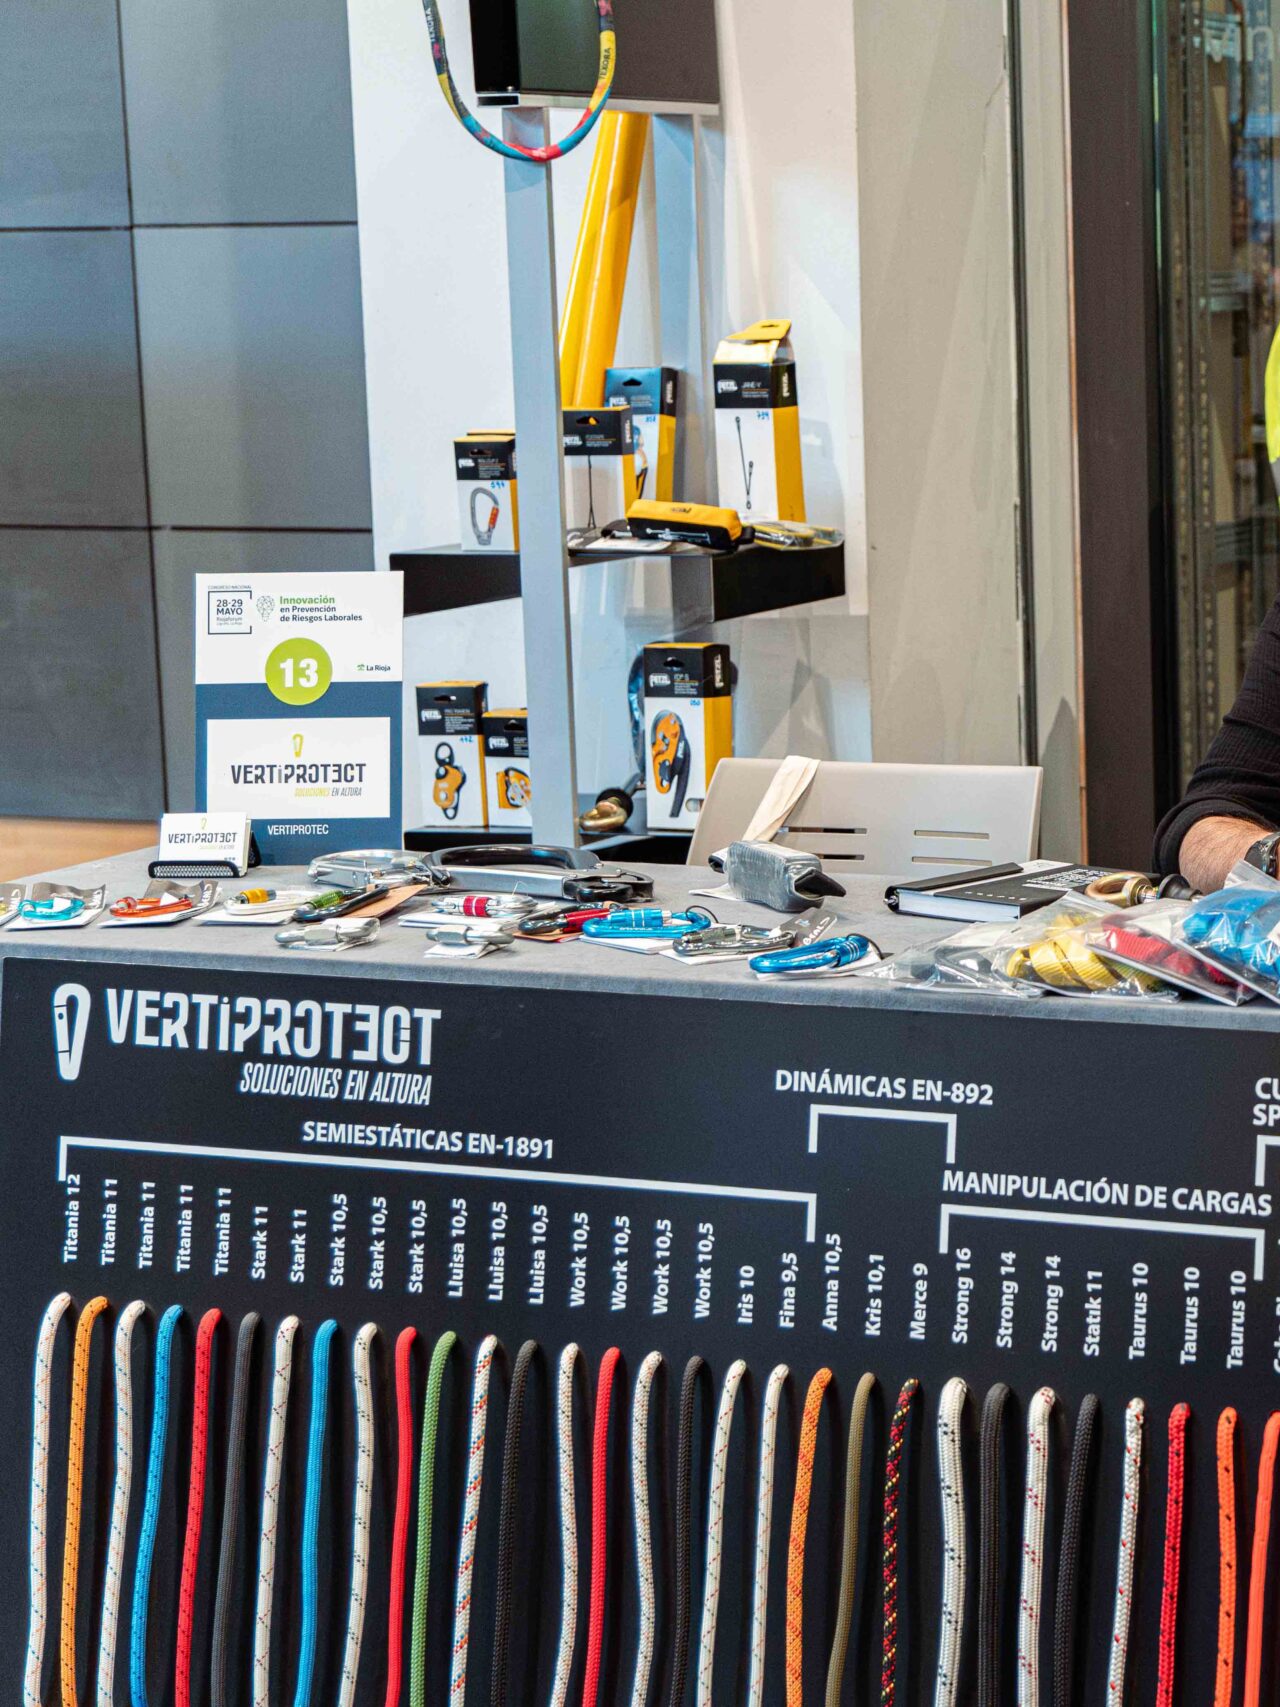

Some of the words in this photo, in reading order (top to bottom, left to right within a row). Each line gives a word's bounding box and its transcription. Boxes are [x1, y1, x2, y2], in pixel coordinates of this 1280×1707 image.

[216, 607, 243, 616] MAYO
[279, 595, 335, 605] Innovación
[280, 614, 291, 622] de
[292, 614, 322, 623] Riesgos
[324, 614, 363, 622] Laborales
[292, 605, 336, 614] Prevención
[279, 657, 319, 688] 13
[375, 663, 391, 673] Rioja
[332, 787, 339, 797] EN
[340, 787, 362, 797] ALTURA
[267, 824, 329, 836] VERTIPROTEC
[240, 1062, 342, 1099] SOLUCIONES
[344, 1070, 369, 1101] EN
[369, 1072, 433, 1106] ALTURA
[776, 1067, 907, 1100] DINÁMICAS
[911, 1079, 994, 1106] EN-892
[302, 1121, 462, 1153] SEMIESTÁTICAS
[467, 1133, 554, 1160] EN-1891
[67, 1174, 81, 1196] 12
[104, 1179, 118, 1198] 11
[142, 1182, 156, 1201] 11
[179, 1185, 194, 1204] 11
[218, 1188, 232, 1207] 11
[942, 1170, 1129, 1206] MANIPULACIÓN
[1134, 1184, 1167, 1209] DE
[1171, 1188, 1273, 1217] CARGAS
[64, 1201, 80, 1263] Titania
[254, 1207, 269, 1225] 11
[293, 1209, 307, 1228] 11
[332, 1194, 349, 1232] 10,5
[372, 1197, 388, 1235] 10,5
[411, 1200, 428, 1238] 10,5
[451, 1199, 468, 1237] 10,5
[492, 1202, 508, 1240] 10,5
[532, 1205, 549, 1244] 10,5
[573, 1213, 590, 1252] 10,5
[101, 1204, 117, 1266] Titania
[138, 1207, 155, 1269] Titania
[176, 1210, 193, 1273] Titania
[214, 1213, 231, 1276] Titania
[614, 1216, 632, 1255] 10,5
[656, 1220, 673, 1259] 10,5
[697, 1223, 715, 1262] 10,5
[825, 1234, 842, 1274] 10,5
[251, 1231, 268, 1280] Stark
[290, 1234, 307, 1283] Stark
[329, 1237, 346, 1287] Stark
[368, 1240, 386, 1290] Stark
[408, 1243, 425, 1294] Stark
[448, 1243, 465, 1297] Lluisa
[488, 1246, 505, 1301] Lluisa
[781, 1253, 798, 1282] 9,5
[868, 1255, 885, 1293] 10,1
[913, 1263, 928, 1276] 9
[956, 1248, 972, 1271] 16
[1000, 1251, 1016, 1275] 14
[1045, 1255, 1061, 1279] 14
[1132, 1263, 1149, 1286] 10
[529, 1250, 546, 1305] Lluisa
[570, 1257, 587, 1308] Work
[611, 1260, 628, 1311] Work
[652, 1264, 670, 1315] Work
[694, 1267, 712, 1319] Work
[740, 1265, 755, 1288] 10
[1087, 1271, 1103, 1292] 11
[1184, 1267, 1200, 1291] 10
[1230, 1271, 1247, 1295] 10
[737, 1294, 754, 1324] Iris
[779, 1287, 796, 1329] Fina
[822, 1280, 840, 1332] Anna
[865, 1298, 883, 1336] Kris
[910, 1278, 927, 1340] Merce
[952, 1277, 974, 1344] Strong
[996, 1281, 1018, 1349] Strong
[1041, 1285, 1063, 1353] Strong
[1129, 1292, 1147, 1360] Taurus
[1180, 1297, 1198, 1365] Taurus
[1226, 1301, 1245, 1369] Taurus
